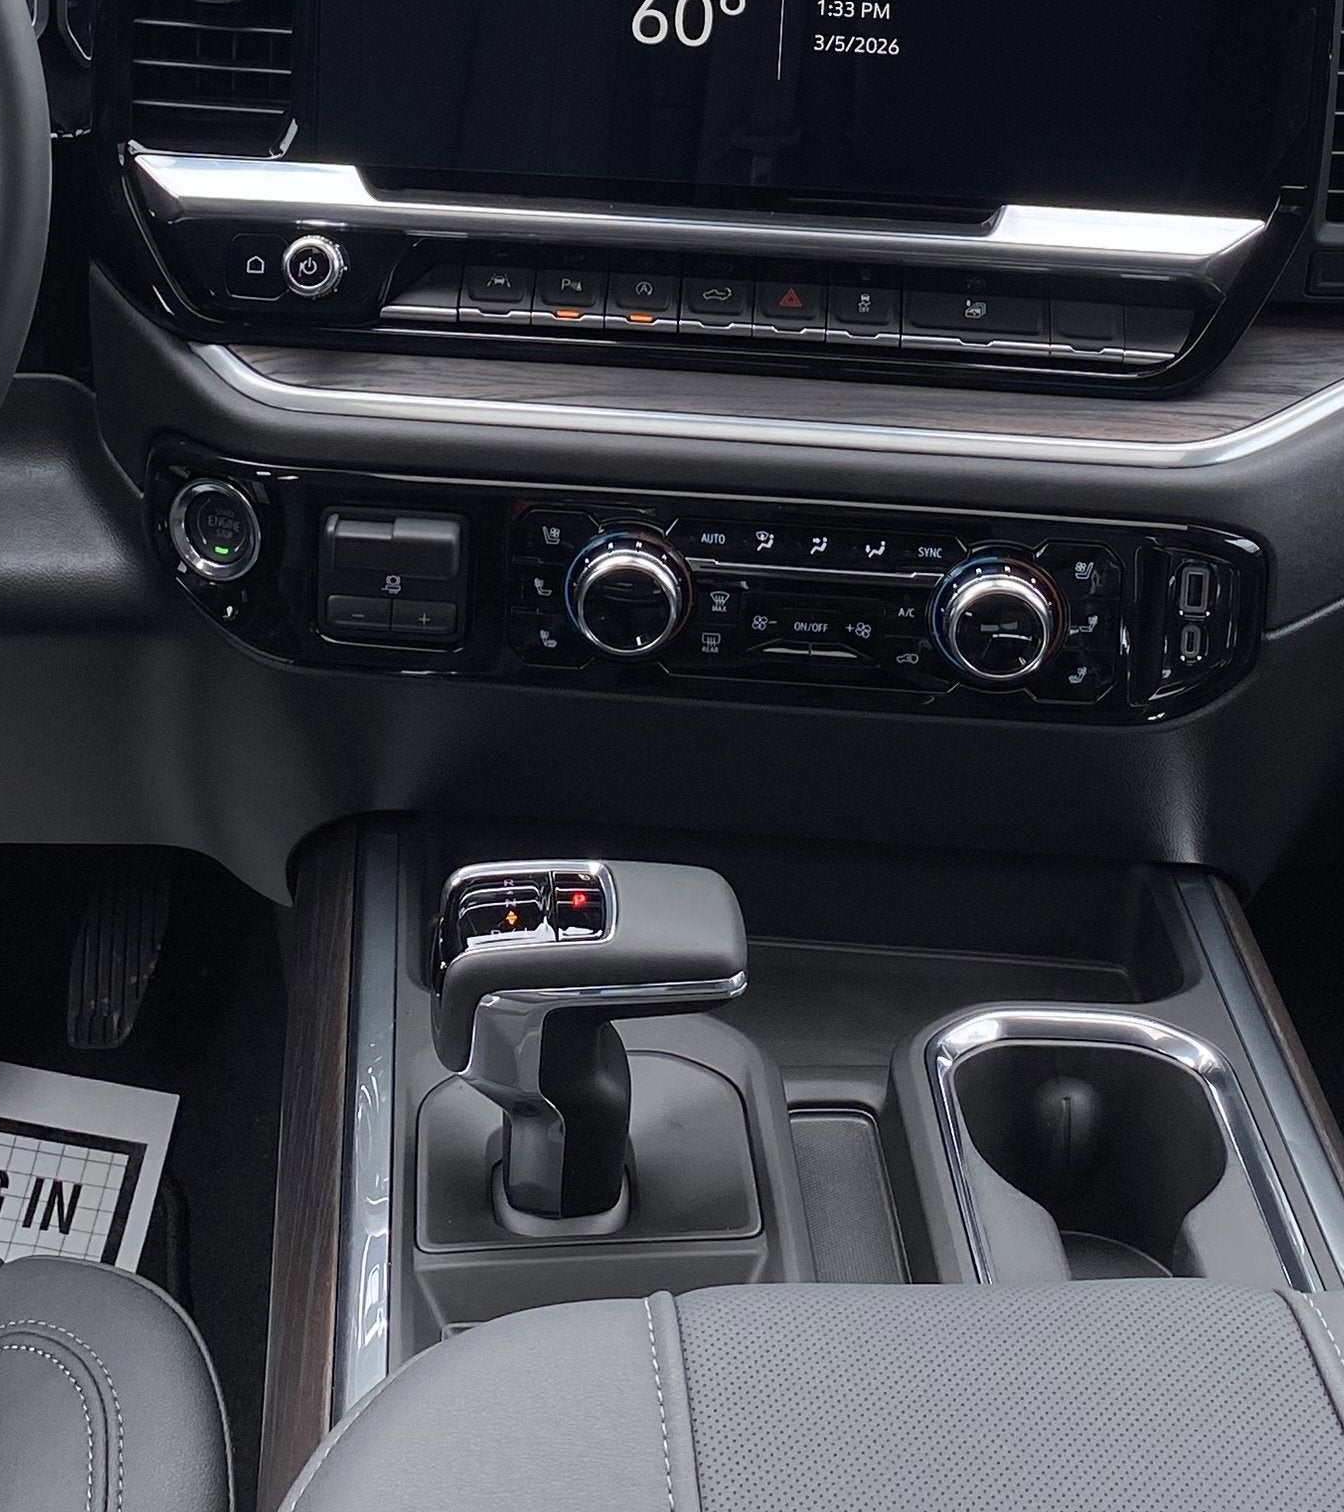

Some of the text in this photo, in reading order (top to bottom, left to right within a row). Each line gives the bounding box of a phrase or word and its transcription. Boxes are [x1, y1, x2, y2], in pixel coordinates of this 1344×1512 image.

[817, 0, 891, 19] 1:33 PM
[813, 34, 900, 55] 3/5/2026
[701, 533, 726, 545] AUTO
[918, 547, 943, 559] SYNC
[712, 605, 727, 613] MAX
[898, 607, 916, 618] A/C
[793, 622, 829, 633] ON/OFF
[572, 891, 587, 907] P
[21, 1177, 83, 1236] IN
